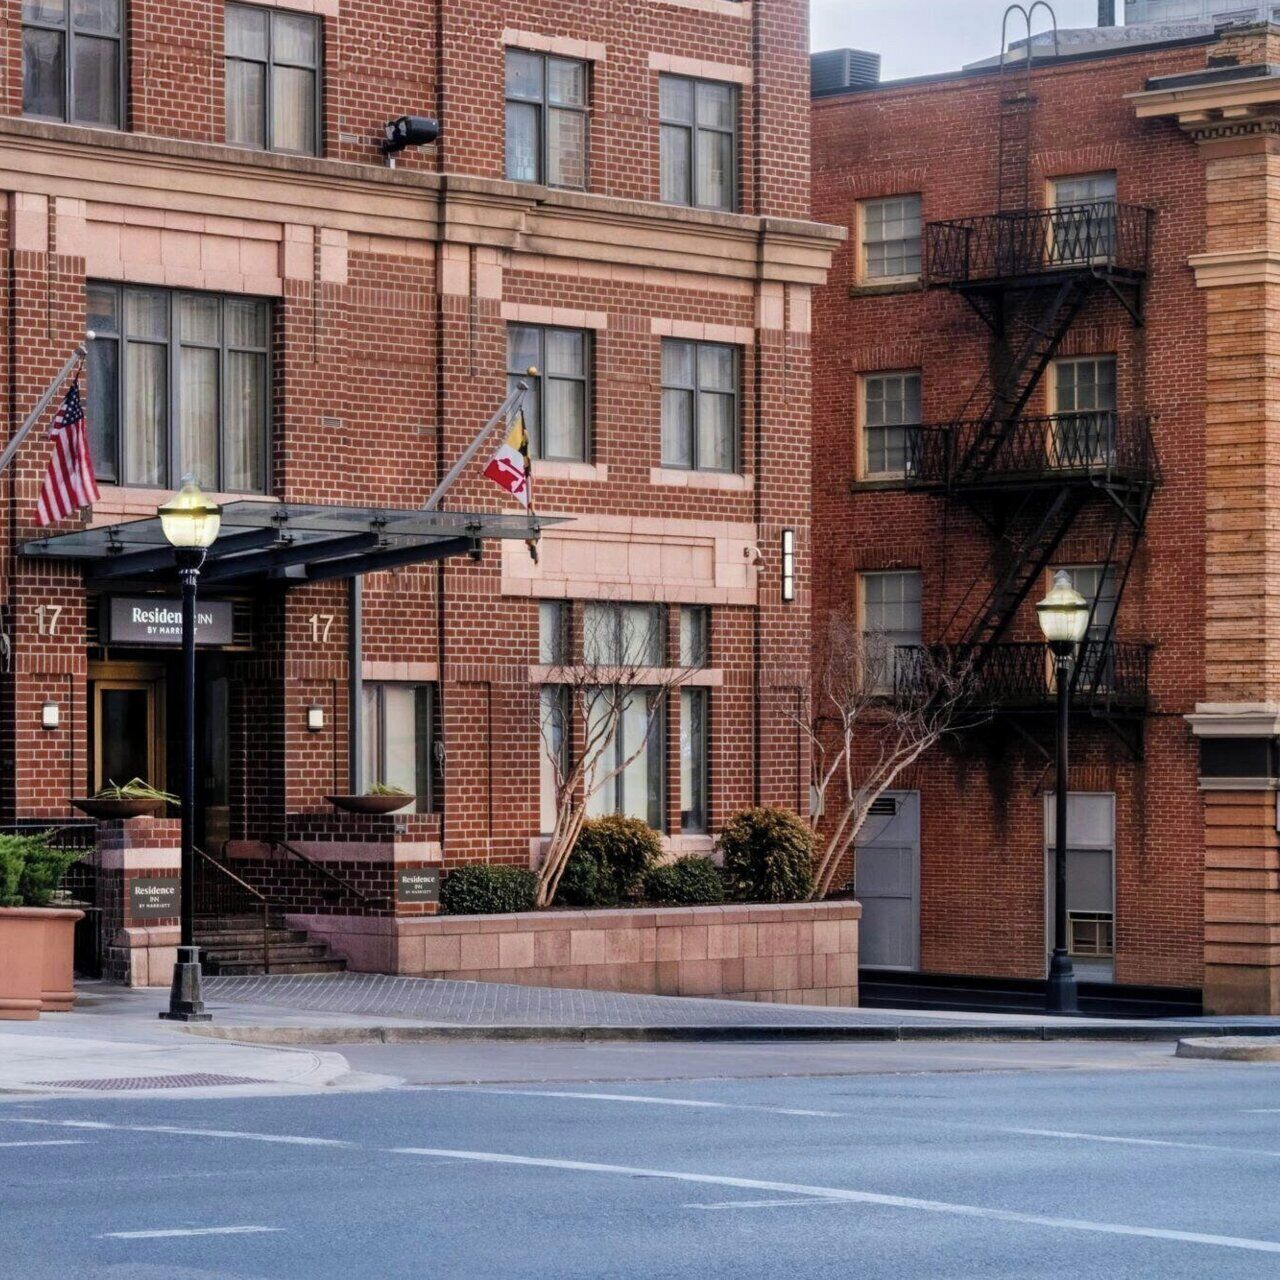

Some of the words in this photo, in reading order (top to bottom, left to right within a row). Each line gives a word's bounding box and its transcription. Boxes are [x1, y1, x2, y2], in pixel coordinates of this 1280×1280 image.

[34, 604, 62, 635] 17
[132, 607, 197, 624] Residen
[198, 613, 213, 625] INN
[147, 626, 157, 634] BY
[159, 626, 198, 635] MARRIT
[309, 614, 334, 642] 17
[402, 875, 436, 883] Residence
[134, 886, 175, 895] Residence
